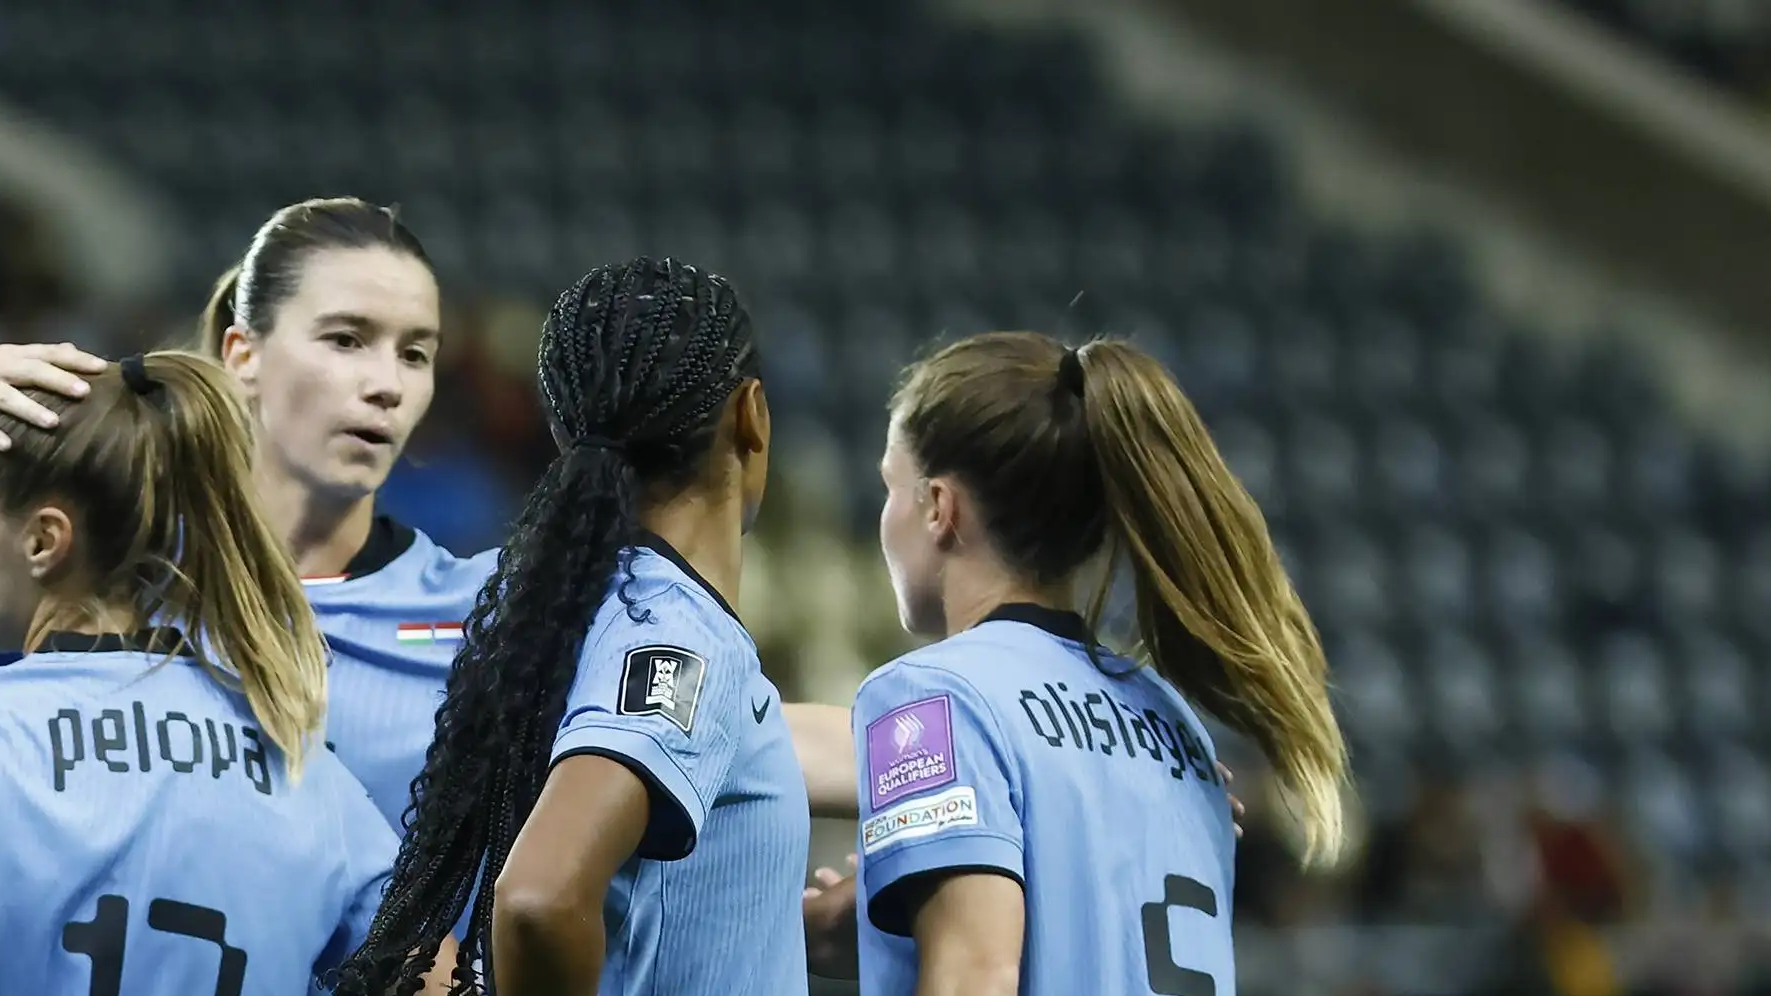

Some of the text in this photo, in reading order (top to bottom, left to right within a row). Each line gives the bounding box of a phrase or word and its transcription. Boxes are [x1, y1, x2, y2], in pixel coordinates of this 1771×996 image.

[878, 762, 947, 796] QUALIFIERS
[879, 752, 945, 785] EUROPEAN
[864, 798, 972, 842] FOUNDATION
